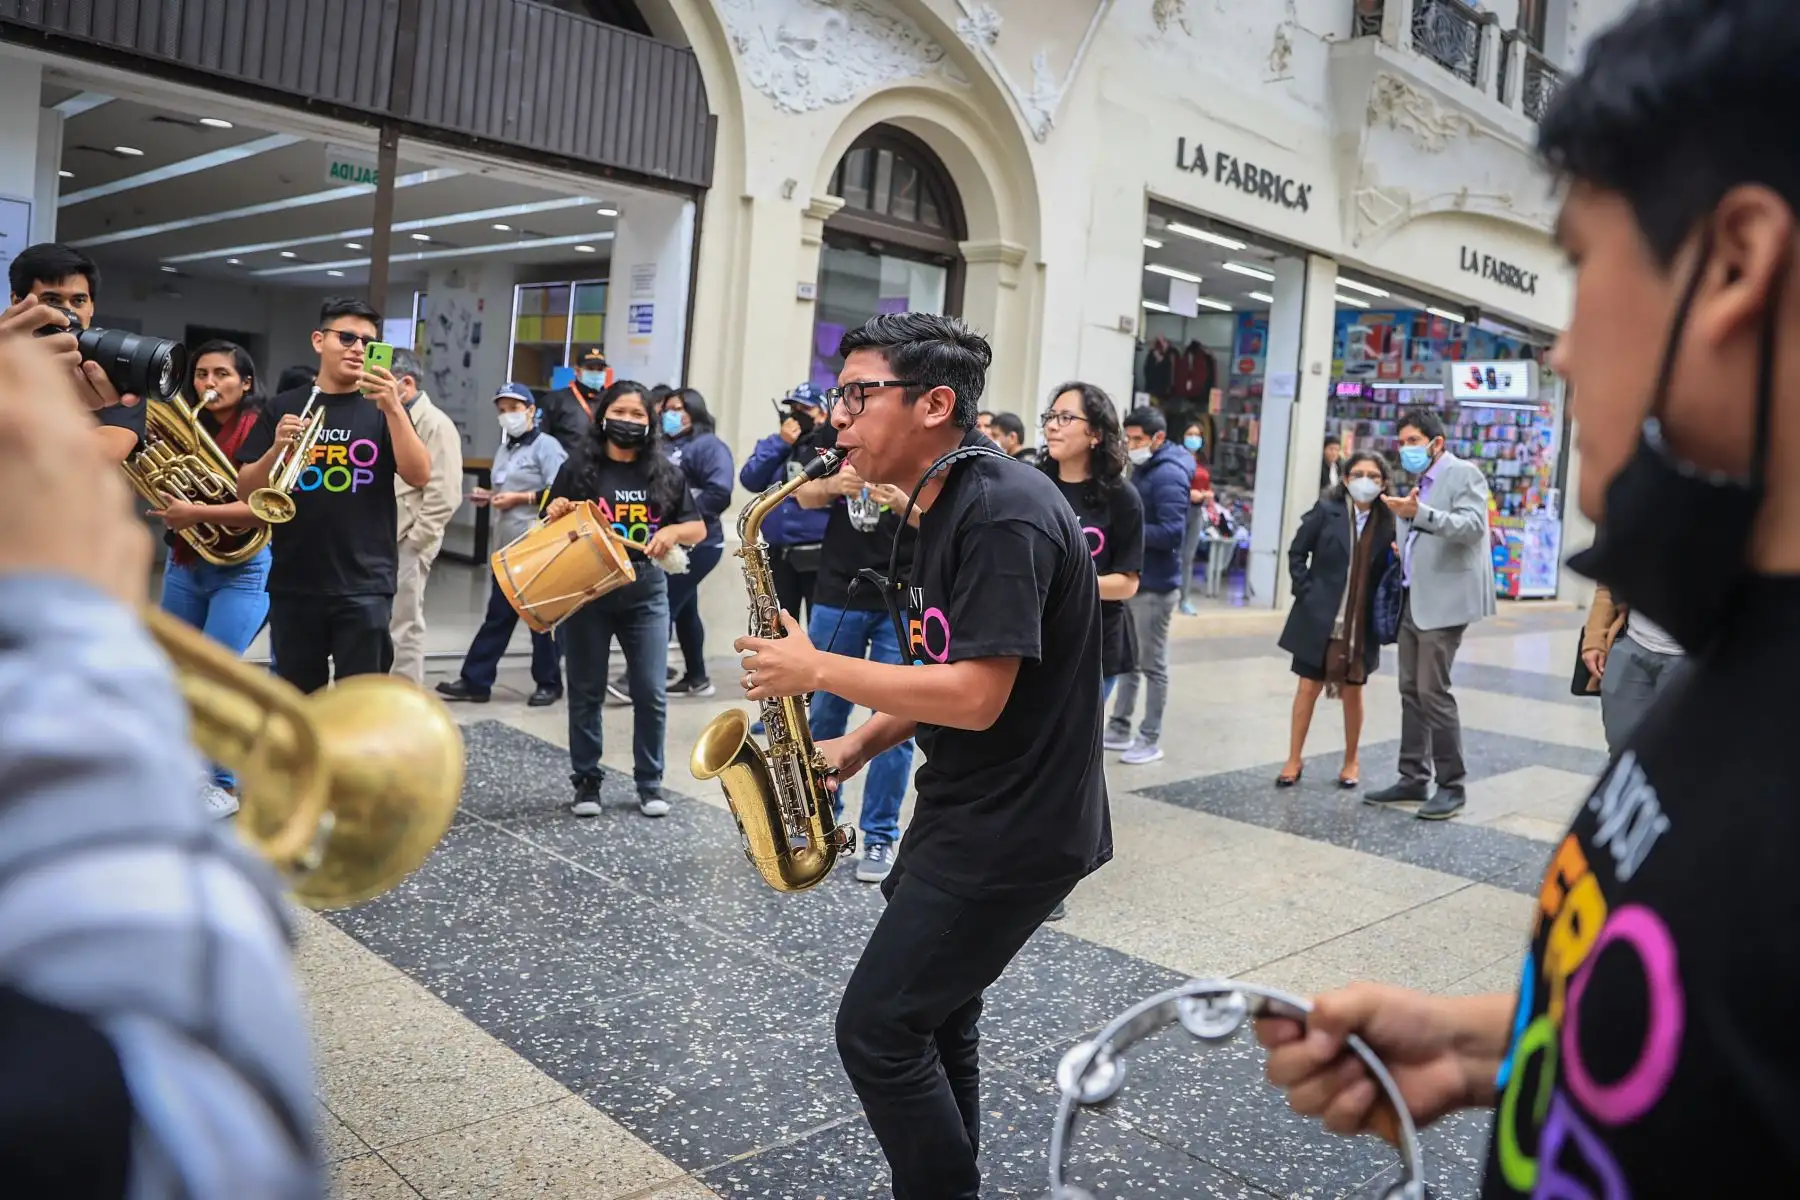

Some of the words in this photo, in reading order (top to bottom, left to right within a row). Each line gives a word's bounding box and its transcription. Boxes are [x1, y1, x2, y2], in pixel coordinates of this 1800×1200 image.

[1176, 136, 1208, 177] LA
[1460, 245, 1479, 274] LA
[316, 428, 351, 443] NJCU
[308, 438, 379, 468] FRO
[292, 465, 375, 493] OOP
[614, 490, 647, 502] NJCU
